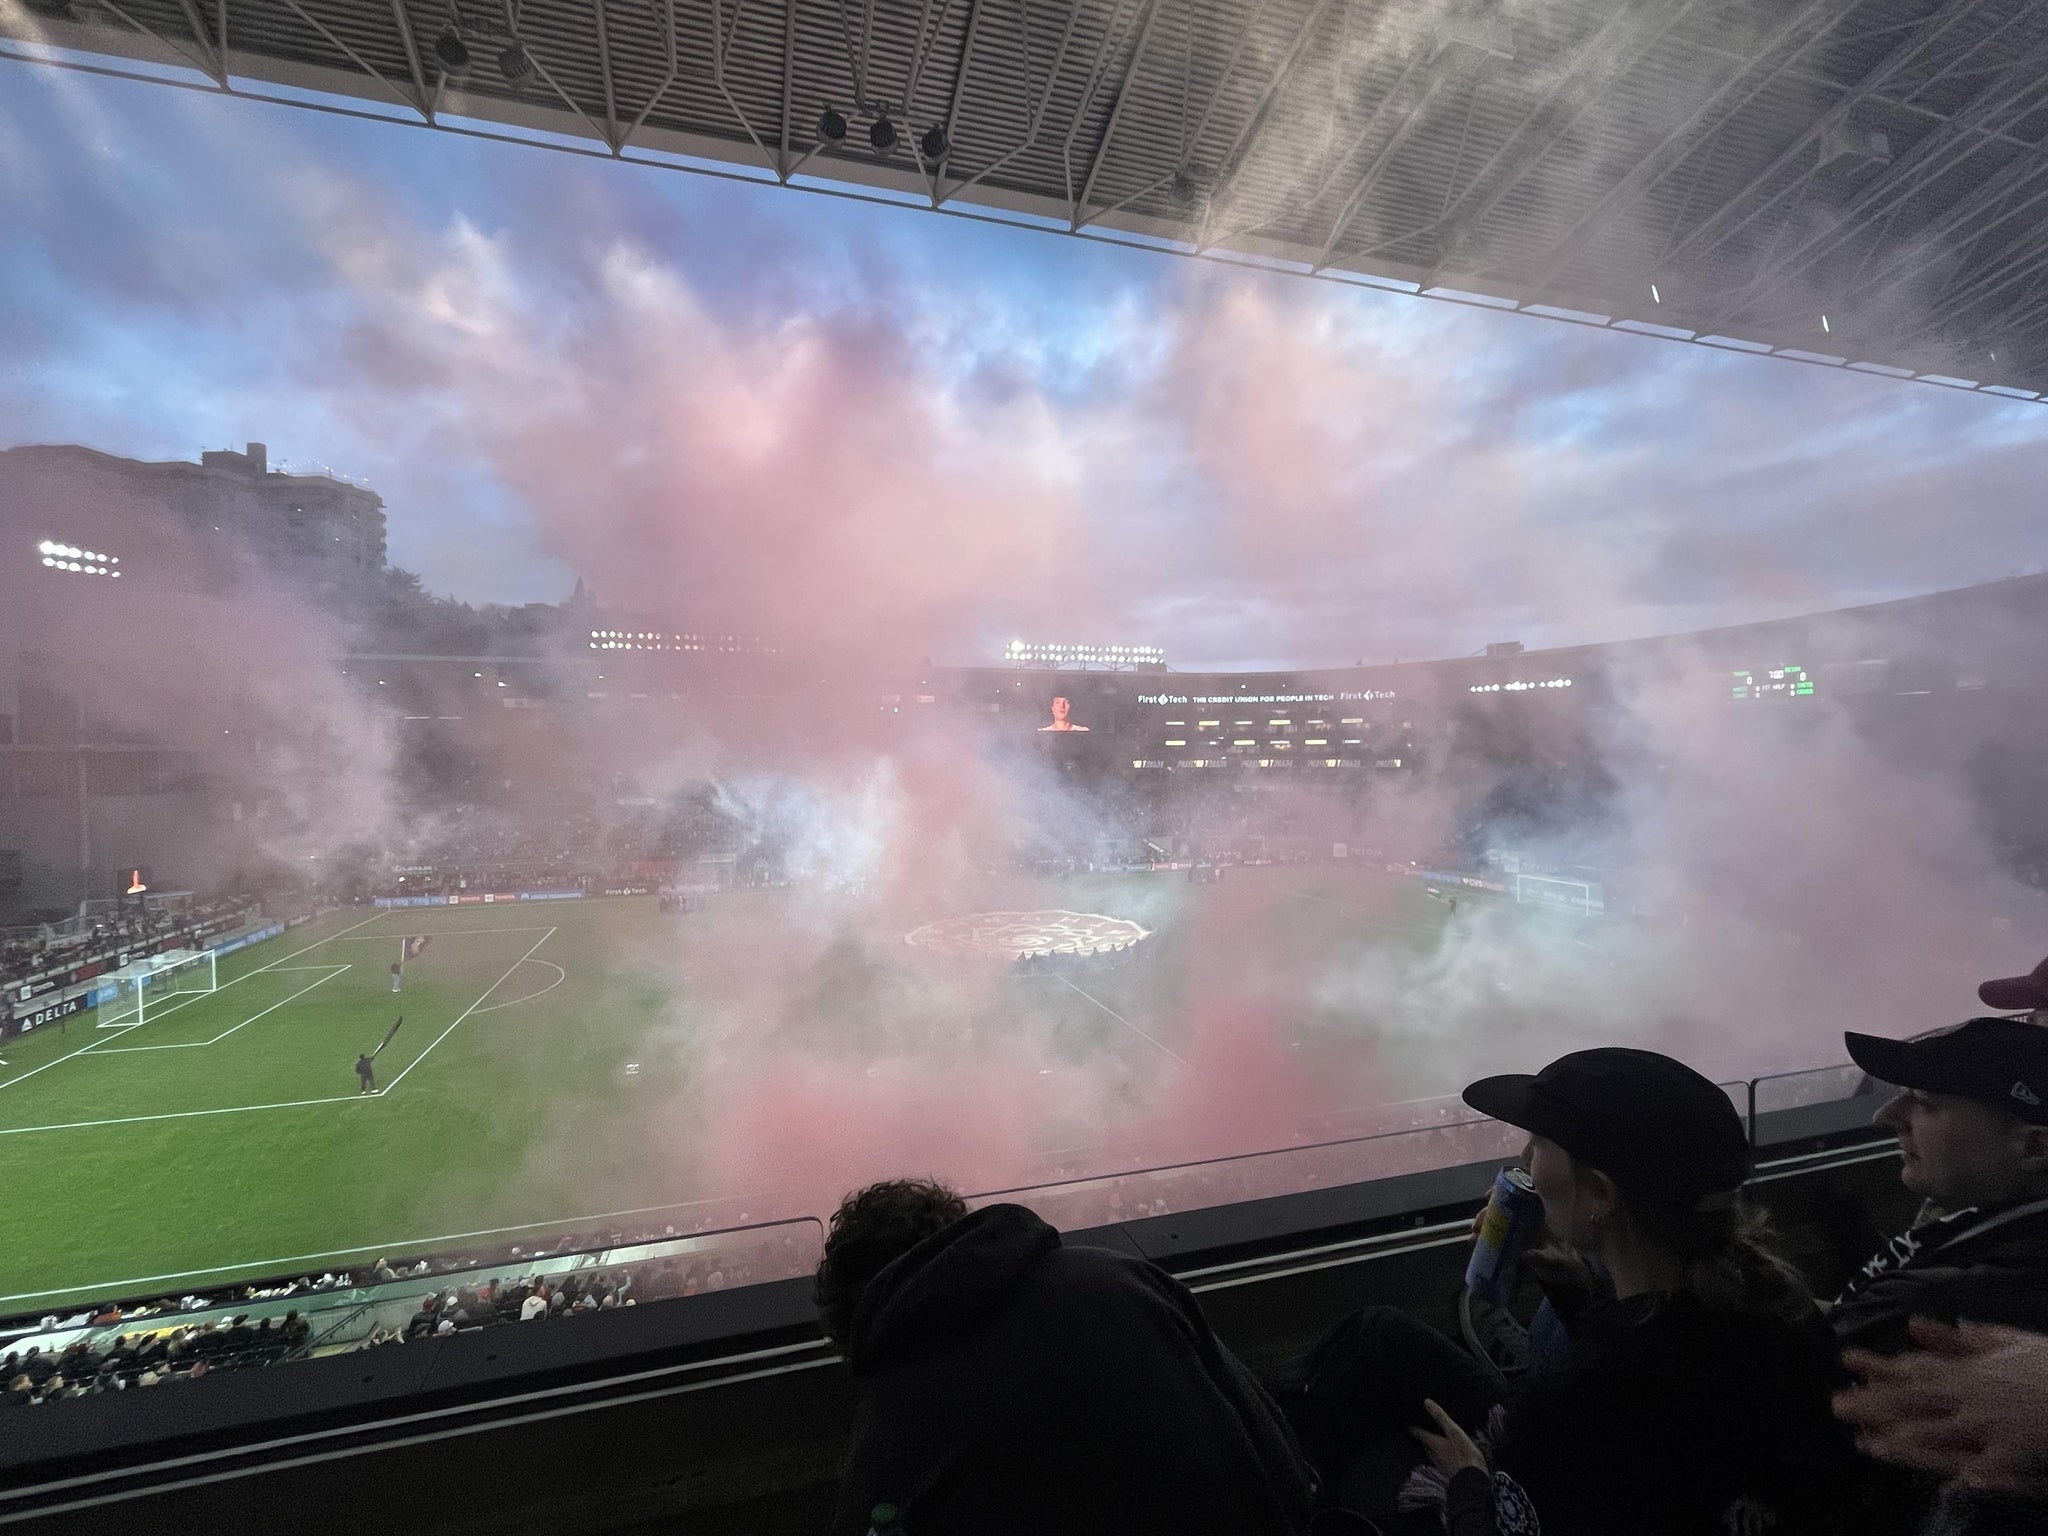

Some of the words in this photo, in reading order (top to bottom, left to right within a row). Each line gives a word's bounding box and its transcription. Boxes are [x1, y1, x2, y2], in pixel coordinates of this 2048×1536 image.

[1768, 670, 1784, 679] 7:00
[1138, 695, 1157, 704] First
[1168, 695, 1188, 703] Tech
[1340, 692, 1361, 700] First
[1374, 690, 1395, 699] Tech
[35, 1001, 77, 1025] DELTA
